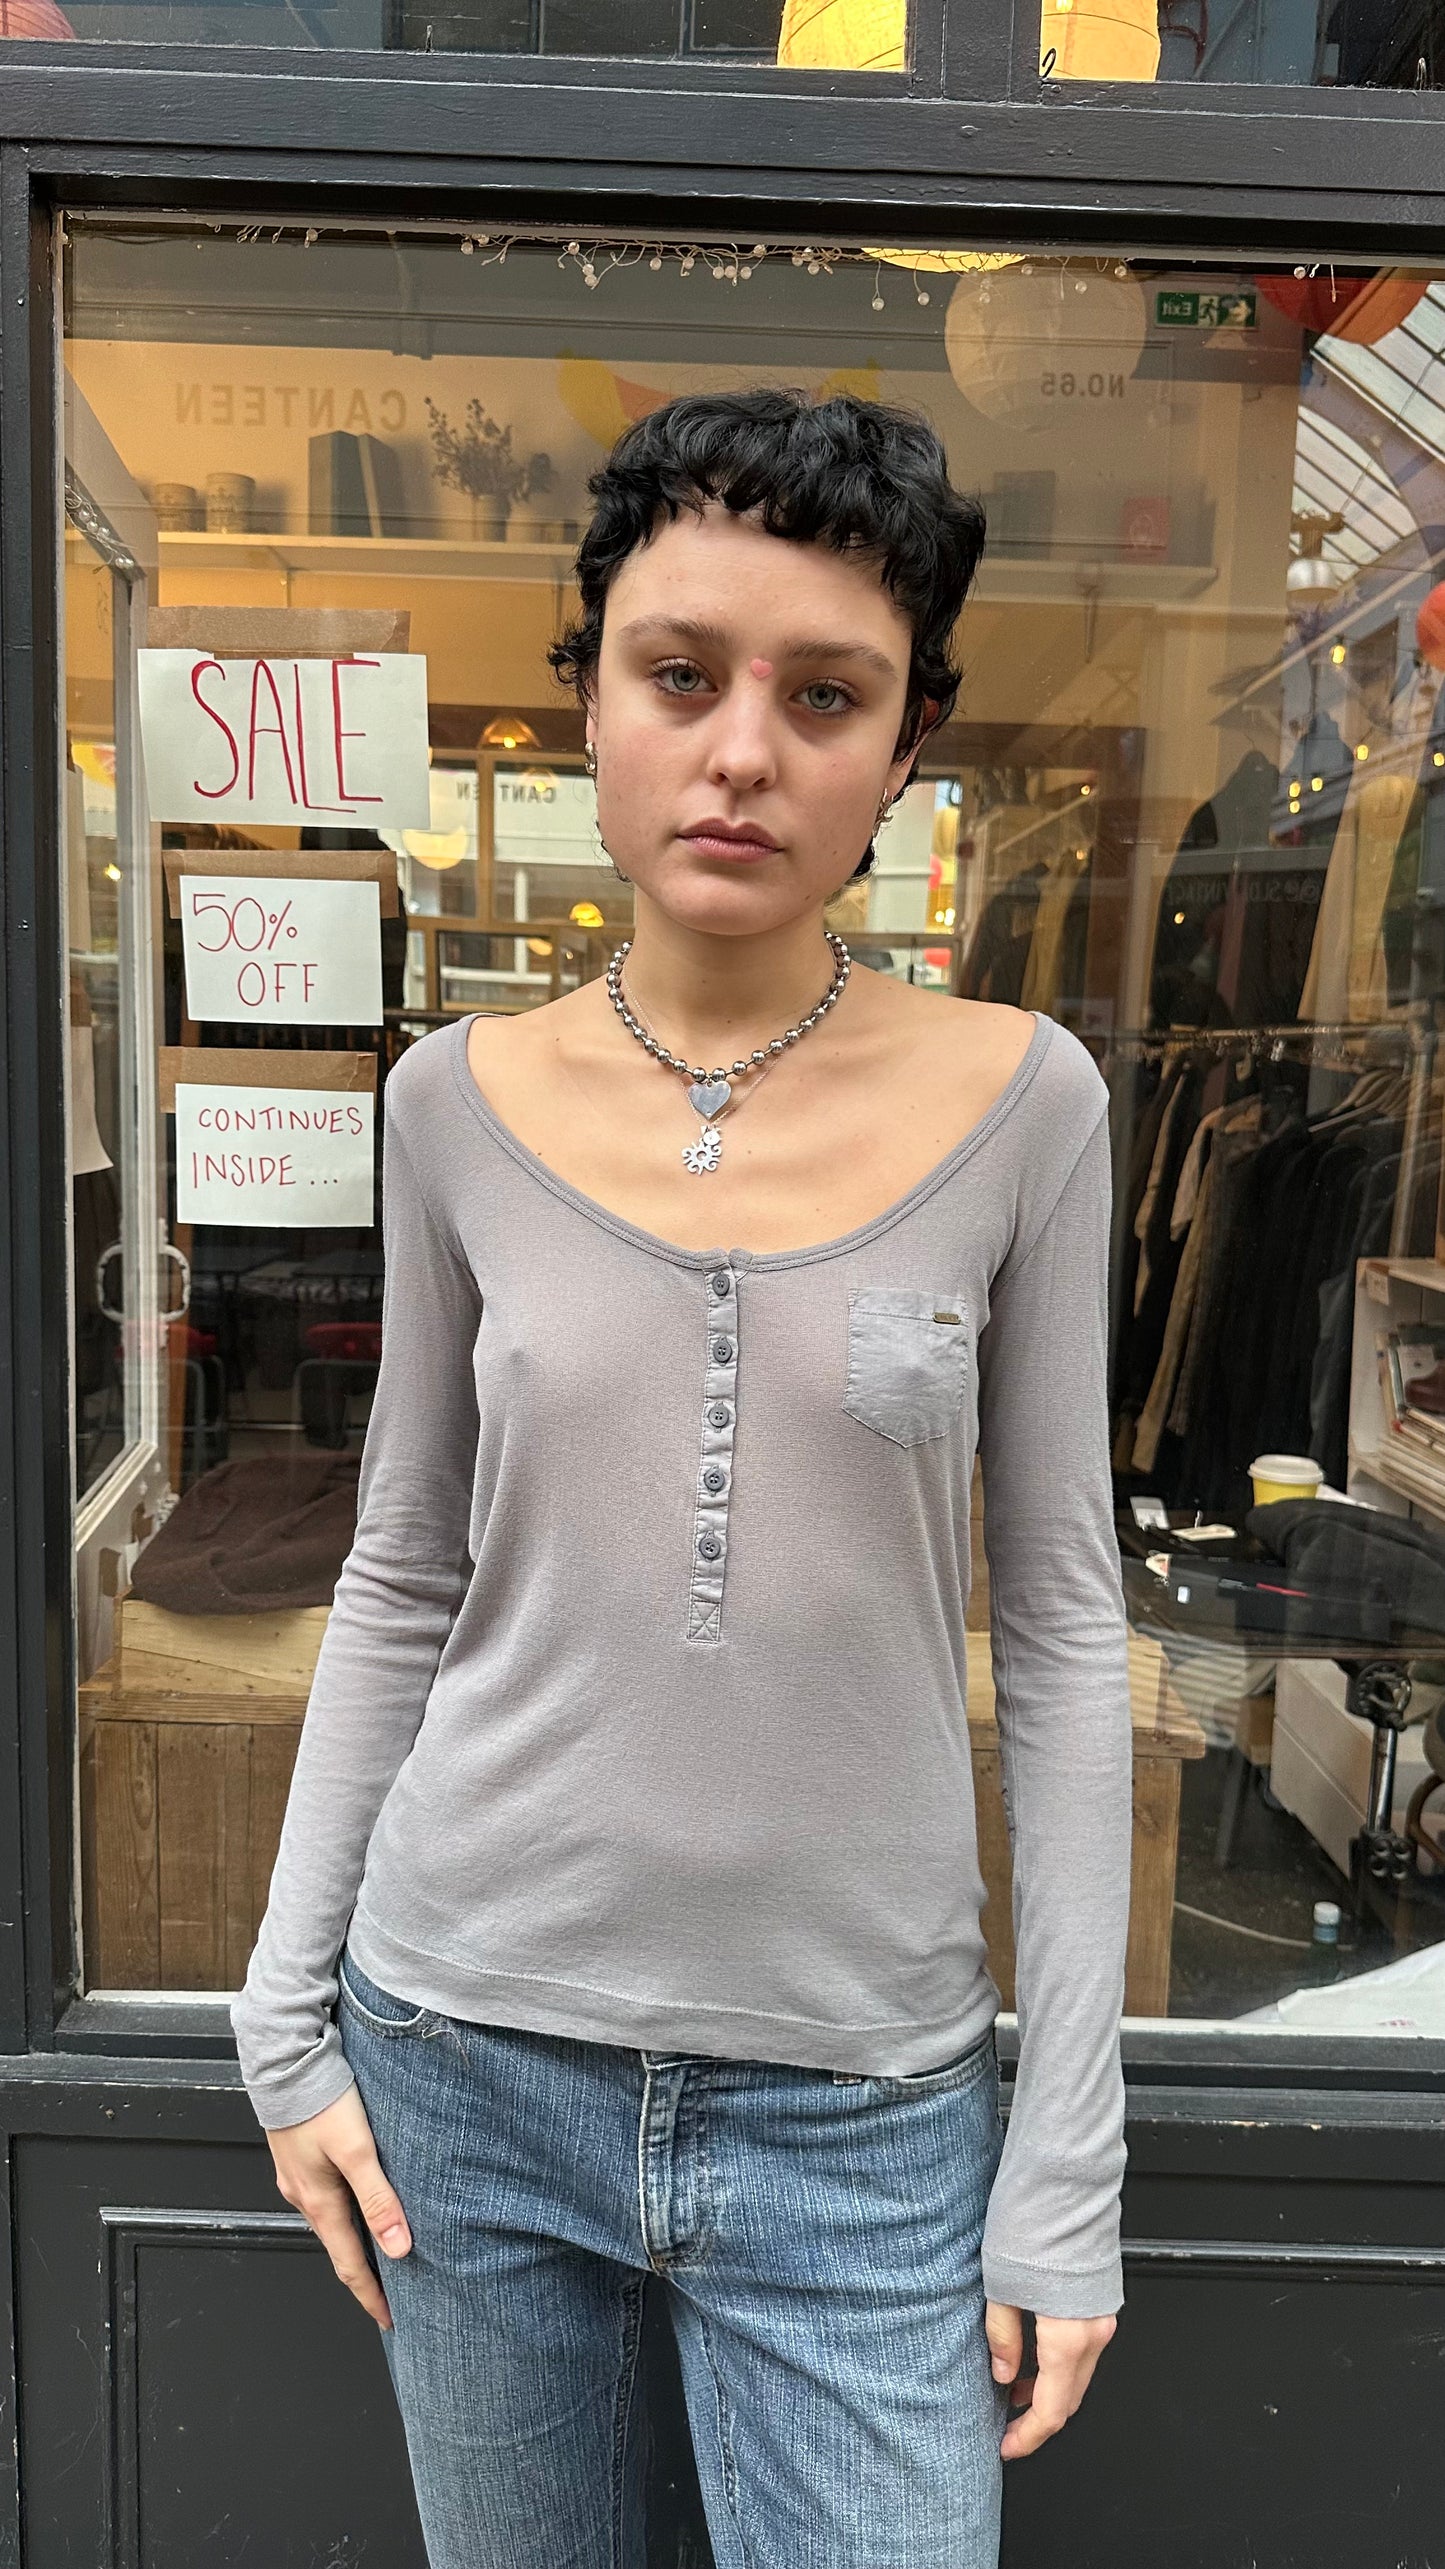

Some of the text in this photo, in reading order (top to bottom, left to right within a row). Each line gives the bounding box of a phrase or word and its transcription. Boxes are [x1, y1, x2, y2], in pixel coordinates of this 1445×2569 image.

[191, 659, 384, 813] SALE
[193, 893, 297, 952] 50%
[237, 962, 318, 1006] OFF
[198, 1106, 363, 1135] CONTINUES
